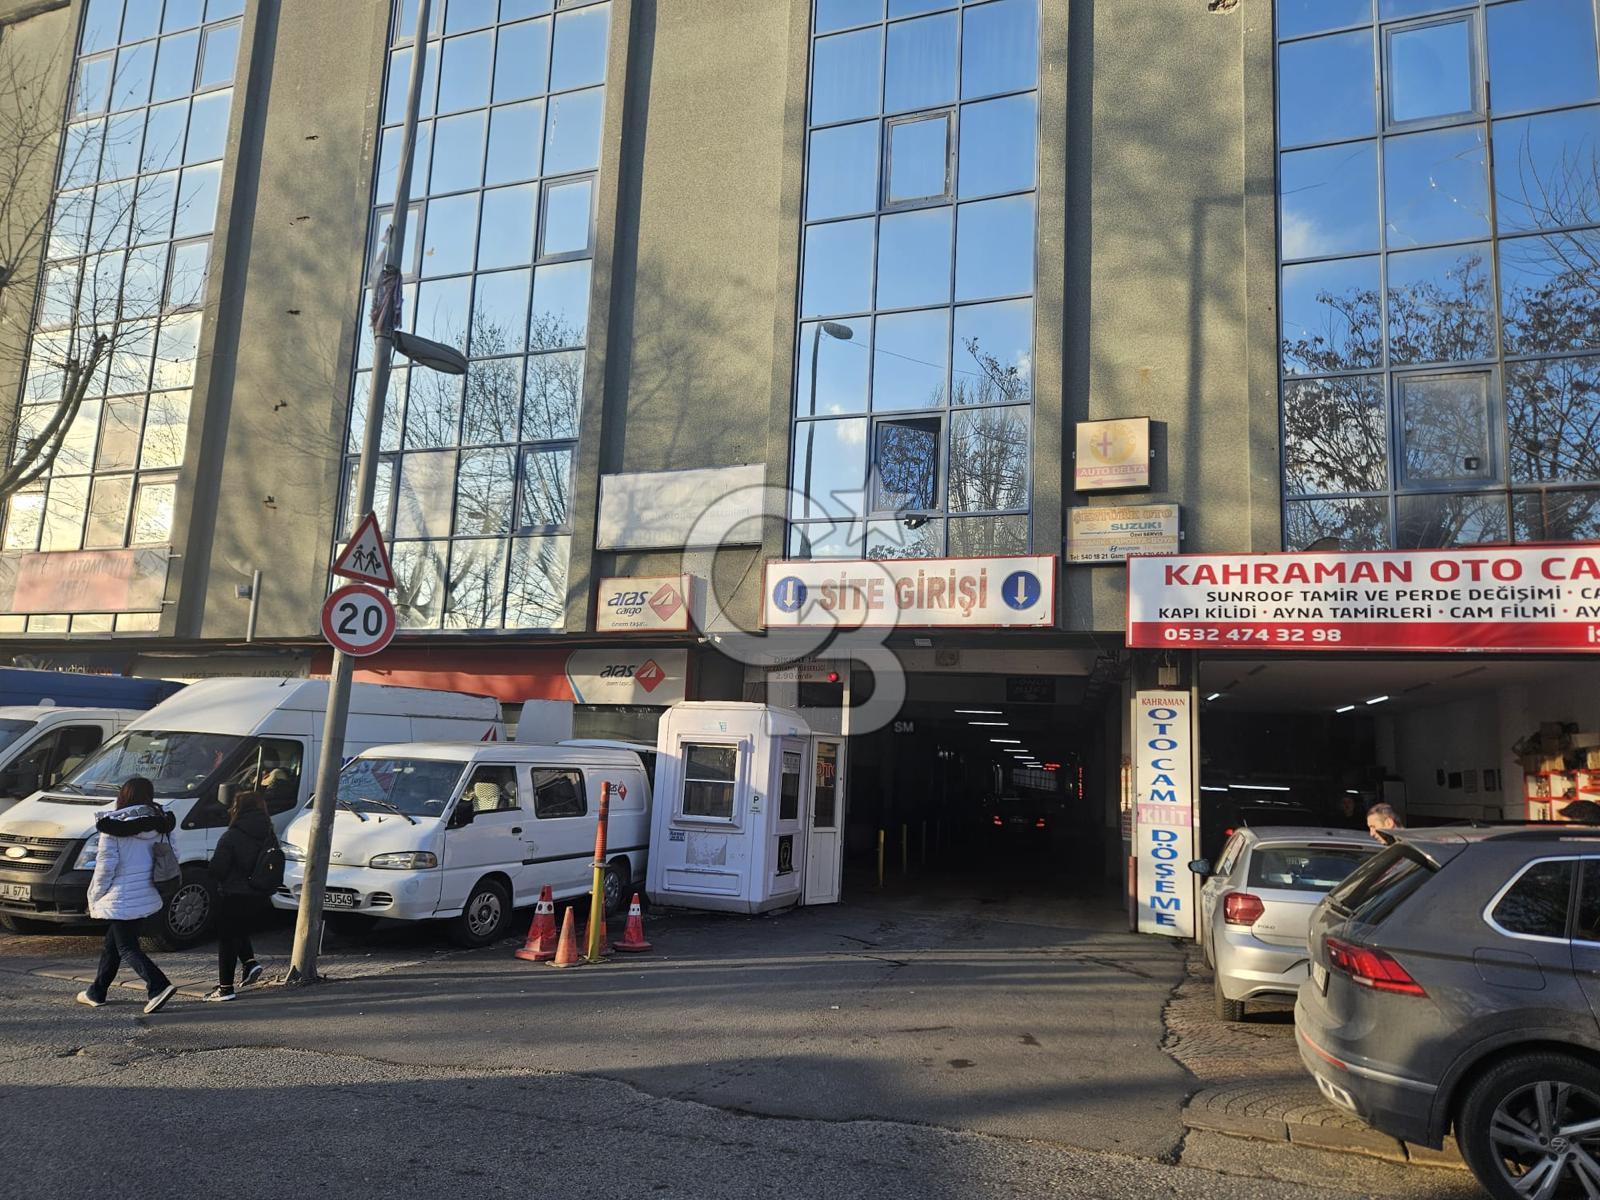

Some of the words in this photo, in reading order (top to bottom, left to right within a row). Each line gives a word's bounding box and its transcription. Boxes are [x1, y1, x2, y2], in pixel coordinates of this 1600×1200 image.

[1111, 521, 1162, 531] SUZUKI
[1164, 560, 1413, 586] KAHRAMAN
[1430, 559, 1522, 582] OTO
[608, 591, 649, 606] aras
[820, 571, 885, 611] SİTE
[895, 567, 987, 617] GİRİŞİ
[1206, 590, 1294, 603] SUNROOF
[1301, 587, 1358, 602] TAMİR
[1365, 590, 1389, 602] VE
[1395, 590, 1462, 602] PERDE
[1468, 585, 1561, 603] DEĞİŞİMİ
[337, 602, 383, 637] 20
[616, 607, 642, 617] cargo
[1158, 607, 1199, 619] KAPI
[1205, 605, 1257, 619] KİLİDİ
[1273, 607, 1324, 619] AYNA
[1330, 604, 1432, 619] TAMİRLERİ
[1450, 606, 1493, 618] CAM
[1500, 603, 1556, 618] FİLMİ
[1164, 628, 1219, 641] 0532
[1226, 628, 1270, 641] 474
[1276, 628, 1305, 642] 32
[1311, 628, 1342, 642] 98
[600, 665, 635, 678] aras
[1141, 697, 1186, 707] KAHRAMAN
[1147, 708, 1178, 751] OTO
[1150, 758, 1178, 802] CAM
[1141, 804, 1187, 824] KİLİT
[1149, 829, 1181, 927] DÖŞEME
